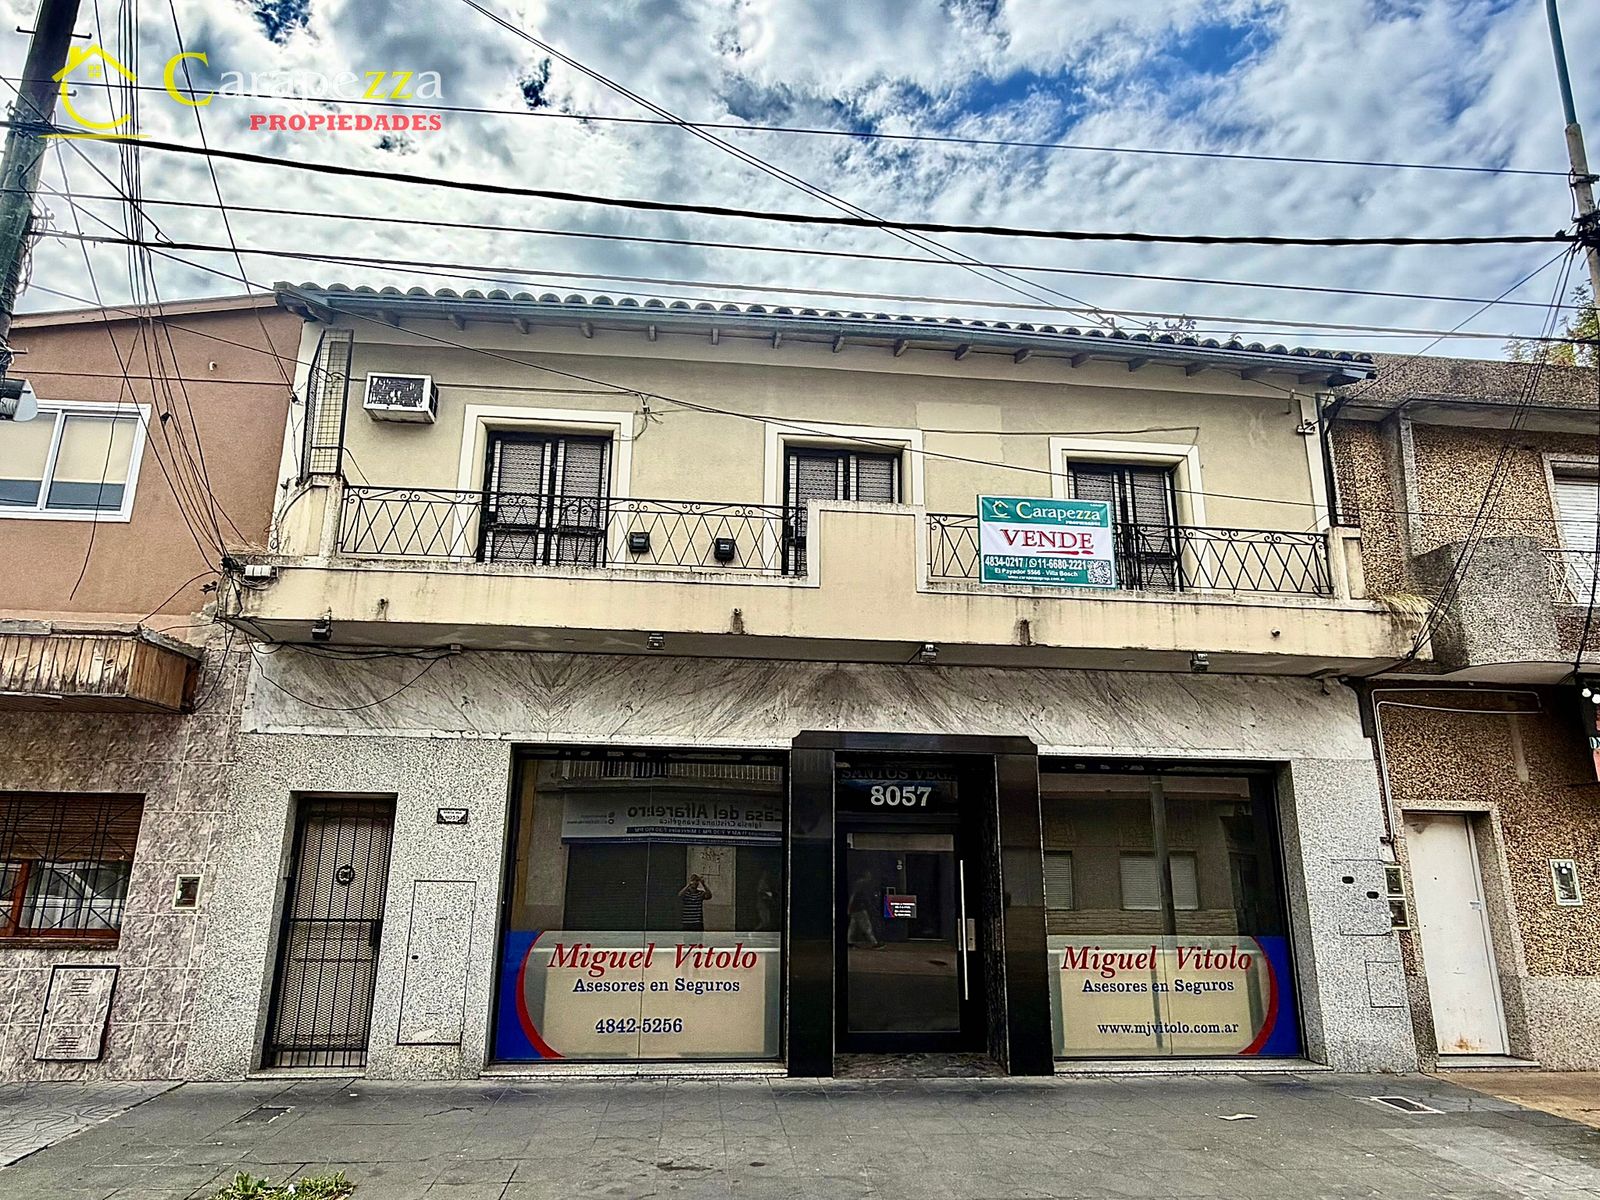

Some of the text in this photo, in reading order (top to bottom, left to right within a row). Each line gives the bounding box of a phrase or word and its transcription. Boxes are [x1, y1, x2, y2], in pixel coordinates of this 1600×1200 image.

[1016, 502, 1100, 521] Carapezza
[1000, 529, 1094, 550] VENDE
[985, 556, 1086, 570] 4834-0217 11-6680-2221
[870, 786, 932, 806] 8057
[547, 943, 757, 977] Miguel Vitolo
[1061, 945, 1252, 978] Miguel Vitolo
[573, 978, 740, 994] Asesores en Seguros
[1082, 979, 1234, 994] Asesores en Seguros
[595, 1018, 683, 1033] 4842-5256
[1097, 1022, 1239, 1036] www.mjvitolo.com.ar
